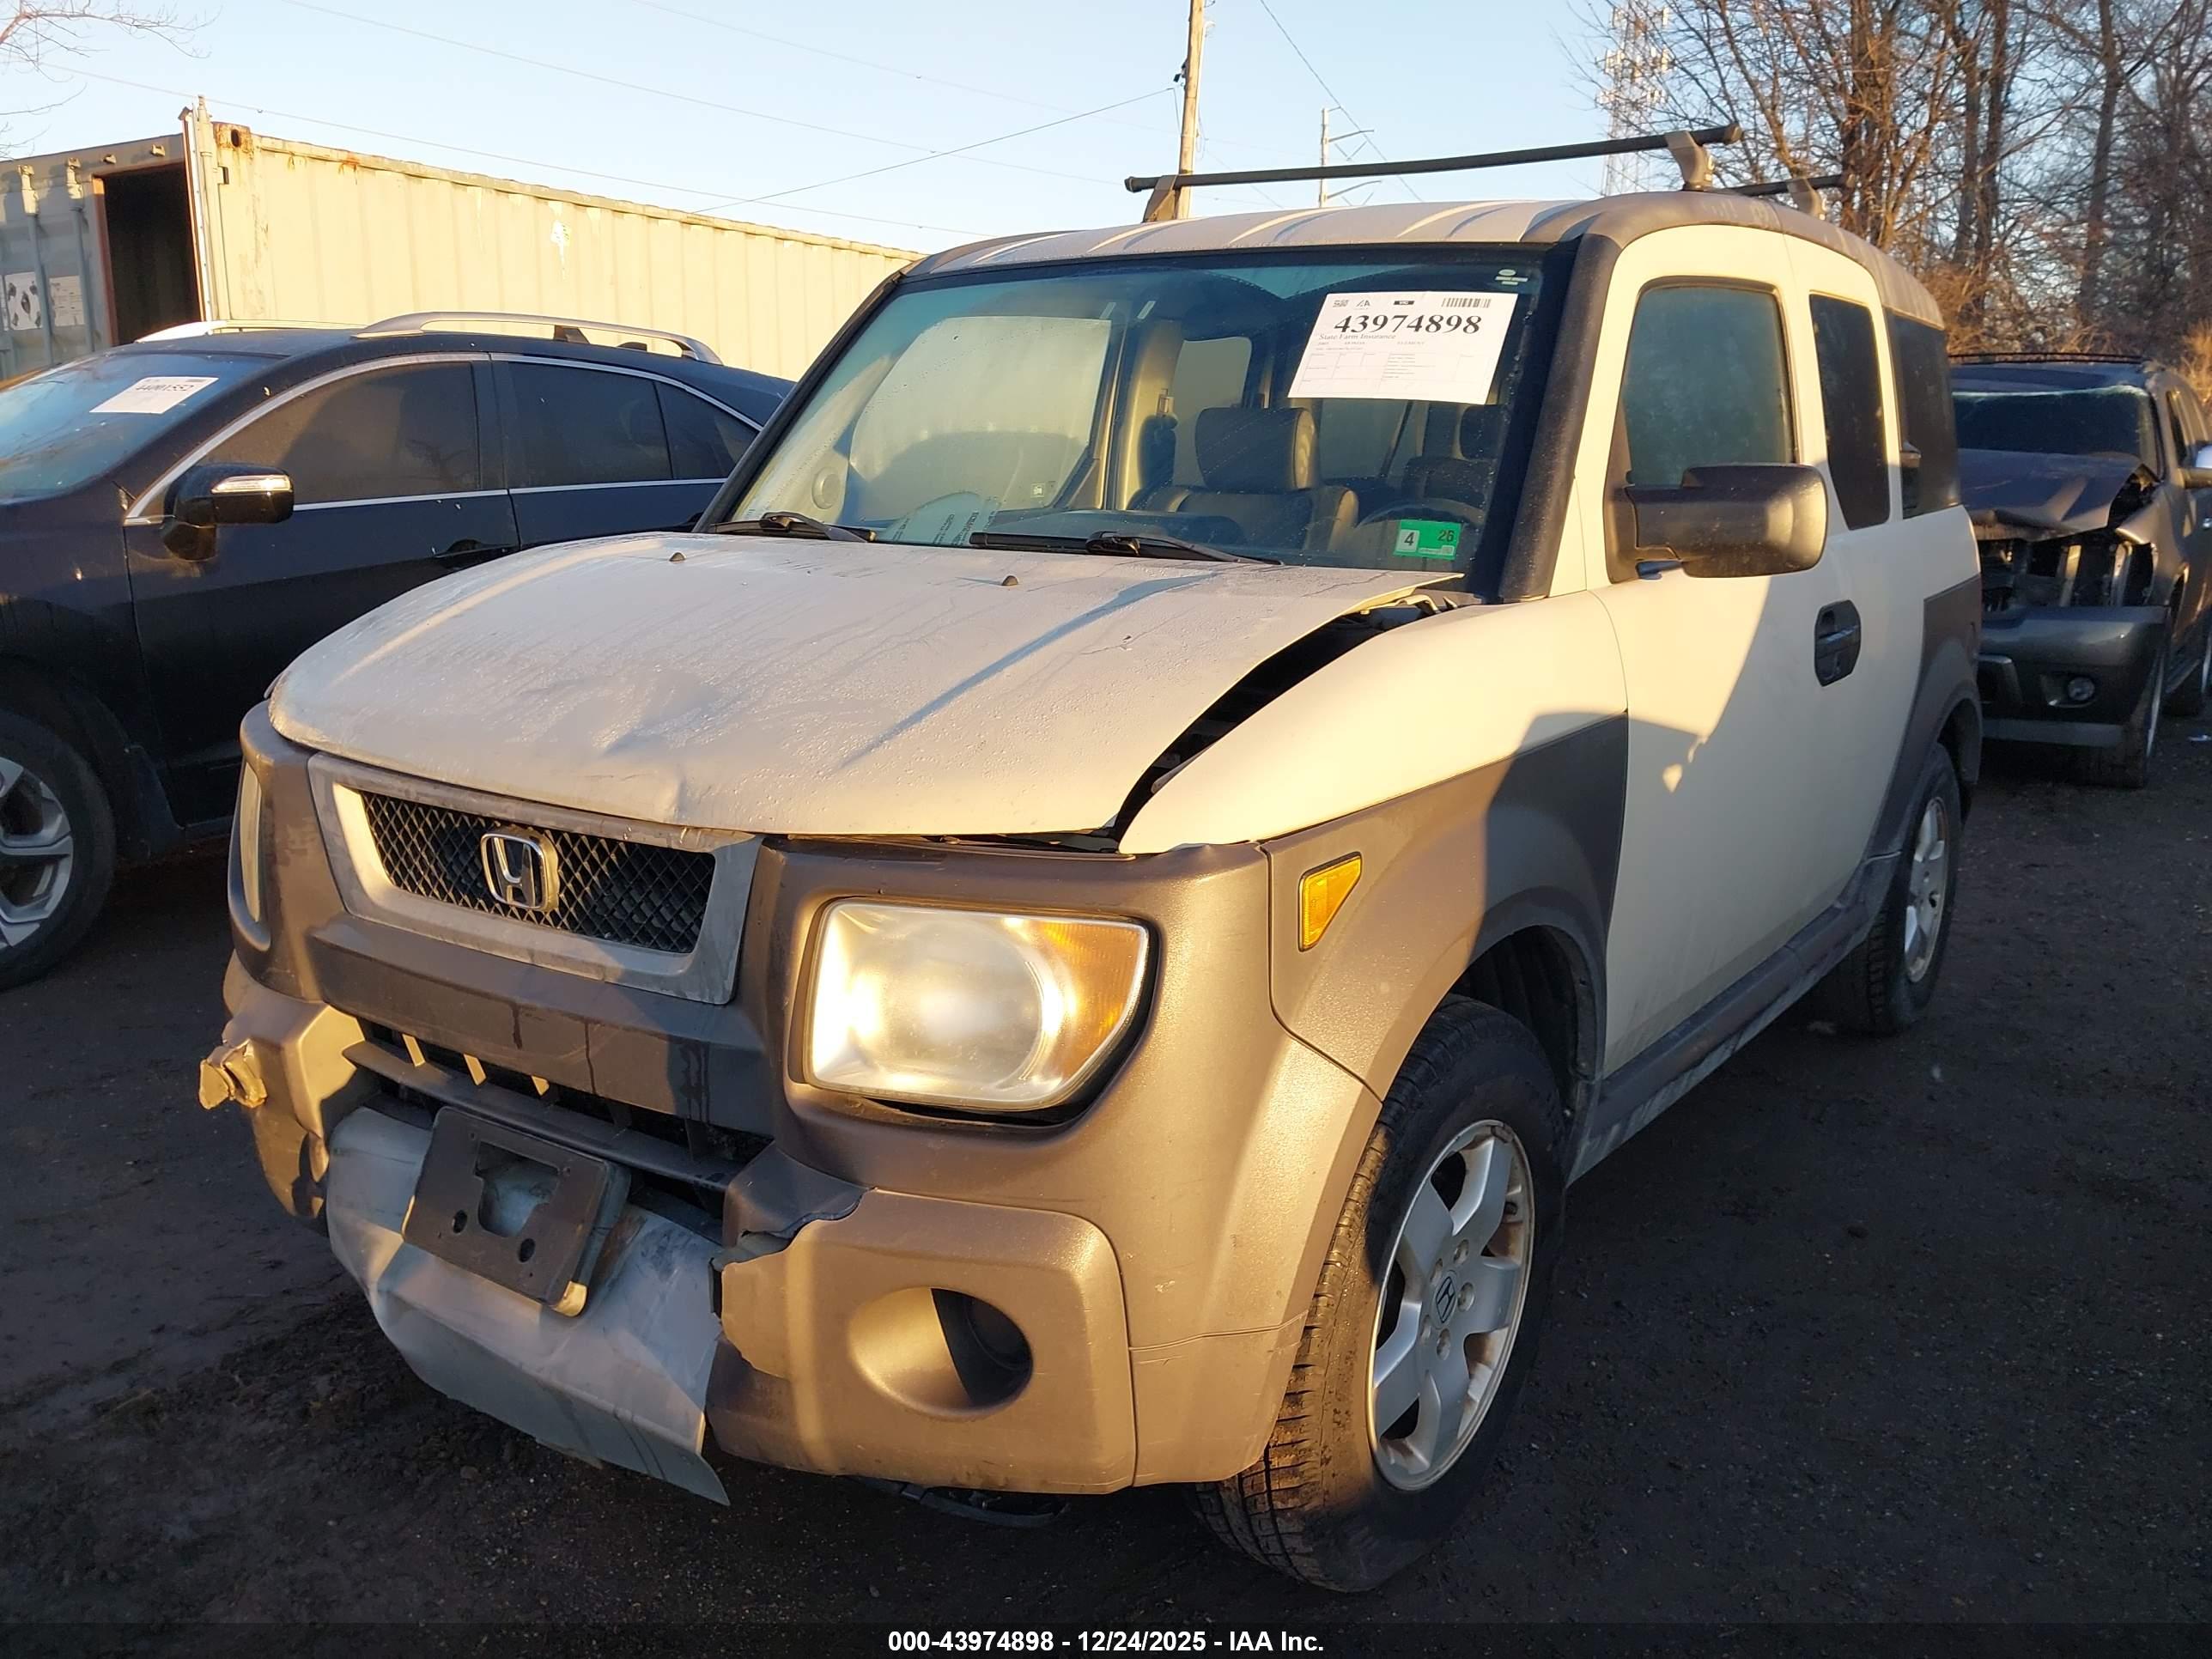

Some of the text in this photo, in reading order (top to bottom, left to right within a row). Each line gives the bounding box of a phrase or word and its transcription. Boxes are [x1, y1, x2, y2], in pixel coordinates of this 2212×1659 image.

[1334, 314, 1483, 334] 43974898
[1404, 532, 1414, 546] 4
[1437, 530, 1455, 542] 26
